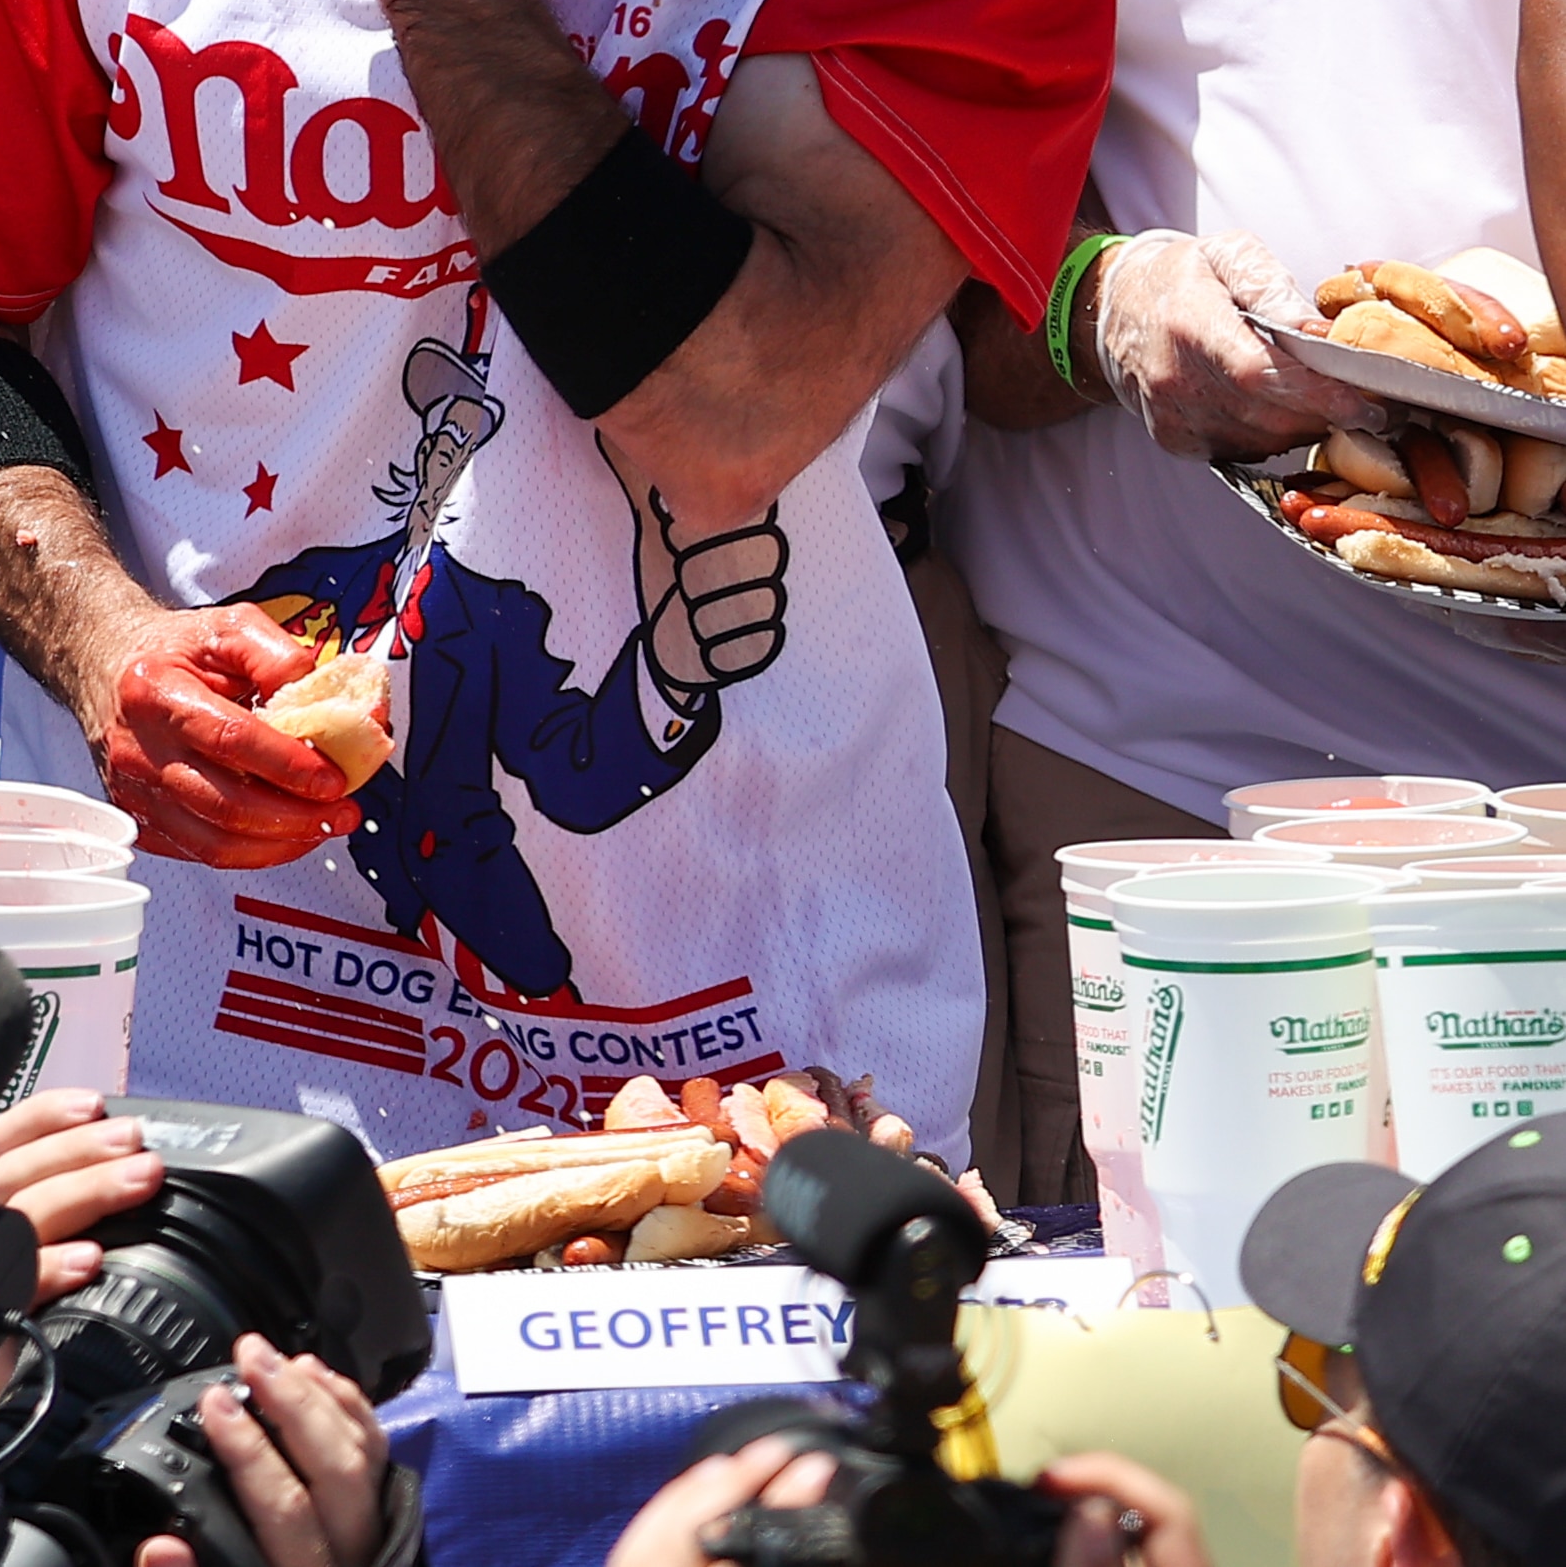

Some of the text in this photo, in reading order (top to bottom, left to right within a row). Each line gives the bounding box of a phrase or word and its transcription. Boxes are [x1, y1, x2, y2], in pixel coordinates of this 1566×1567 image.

[236, 924, 322, 978] HOT
[334, 950, 436, 1004] DOG
[569, 1006, 767, 1066] CONTEST
[1426, 1008, 1566, 1039] Nathan's
[1454, 1066, 1483, 1079] OUR
[1487, 1065, 1530, 1078] FOOD
[1268, 1084, 1315, 1098] MAKES
[519, 1299, 855, 1352] GEOFFREY
